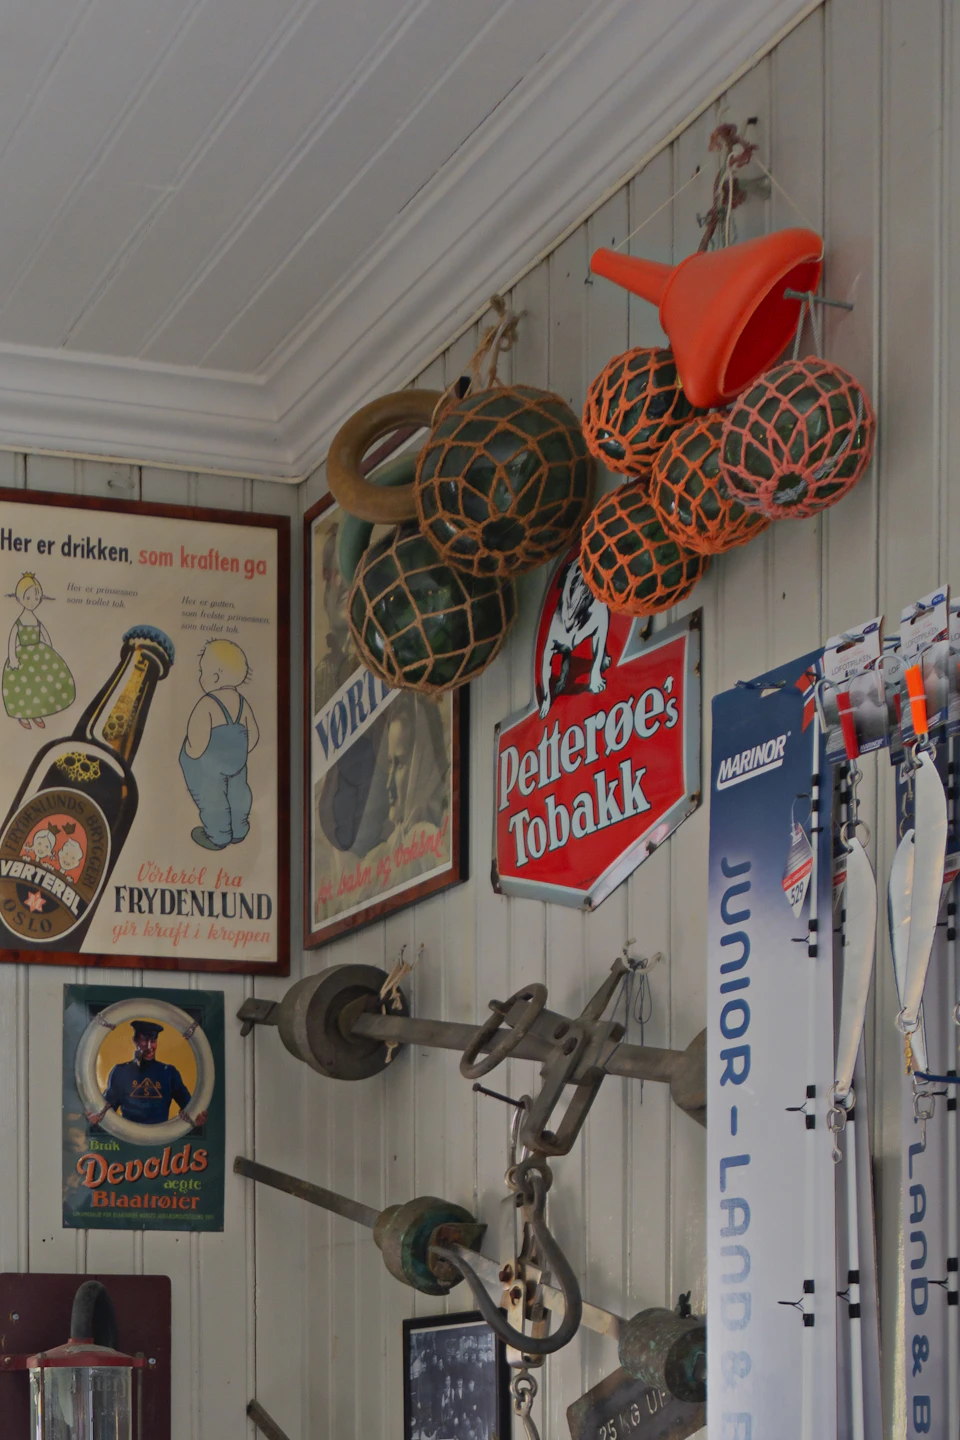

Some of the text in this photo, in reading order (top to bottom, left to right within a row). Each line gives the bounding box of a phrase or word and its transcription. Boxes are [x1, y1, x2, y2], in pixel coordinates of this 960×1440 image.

[0, 528, 267, 580] Her er drikken, som kraften ga
[67, 582, 82, 592] Her
[181, 595, 197, 605] Her
[718, 734, 787, 781] MARINOR
[508, 758, 652, 869] Tobakk
[5, 794, 105, 888] FRYDENLUNDS BRYGGERI
[0, 859, 81, 916] VØRTERØL
[215, 867, 243, 889] fra
[3, 898, 53, 933] OSLO
[114, 885, 273, 921] FRYDENLUND
[112, 920, 270, 948] gir kraft i kroppen
[720, 857, 752, 1087] JUNIOR
[76, 1144, 208, 1189] Devolds
[89, 1140, 120, 1151] Bruk
[92, 1190, 201, 1210] Blaatrøier
[720, 1153, 752, 1329] LAND
[908, 1143, 929, 1316] LAND
[720, 1349, 753, 1386] &
[911, 1335, 930, 1378] &
